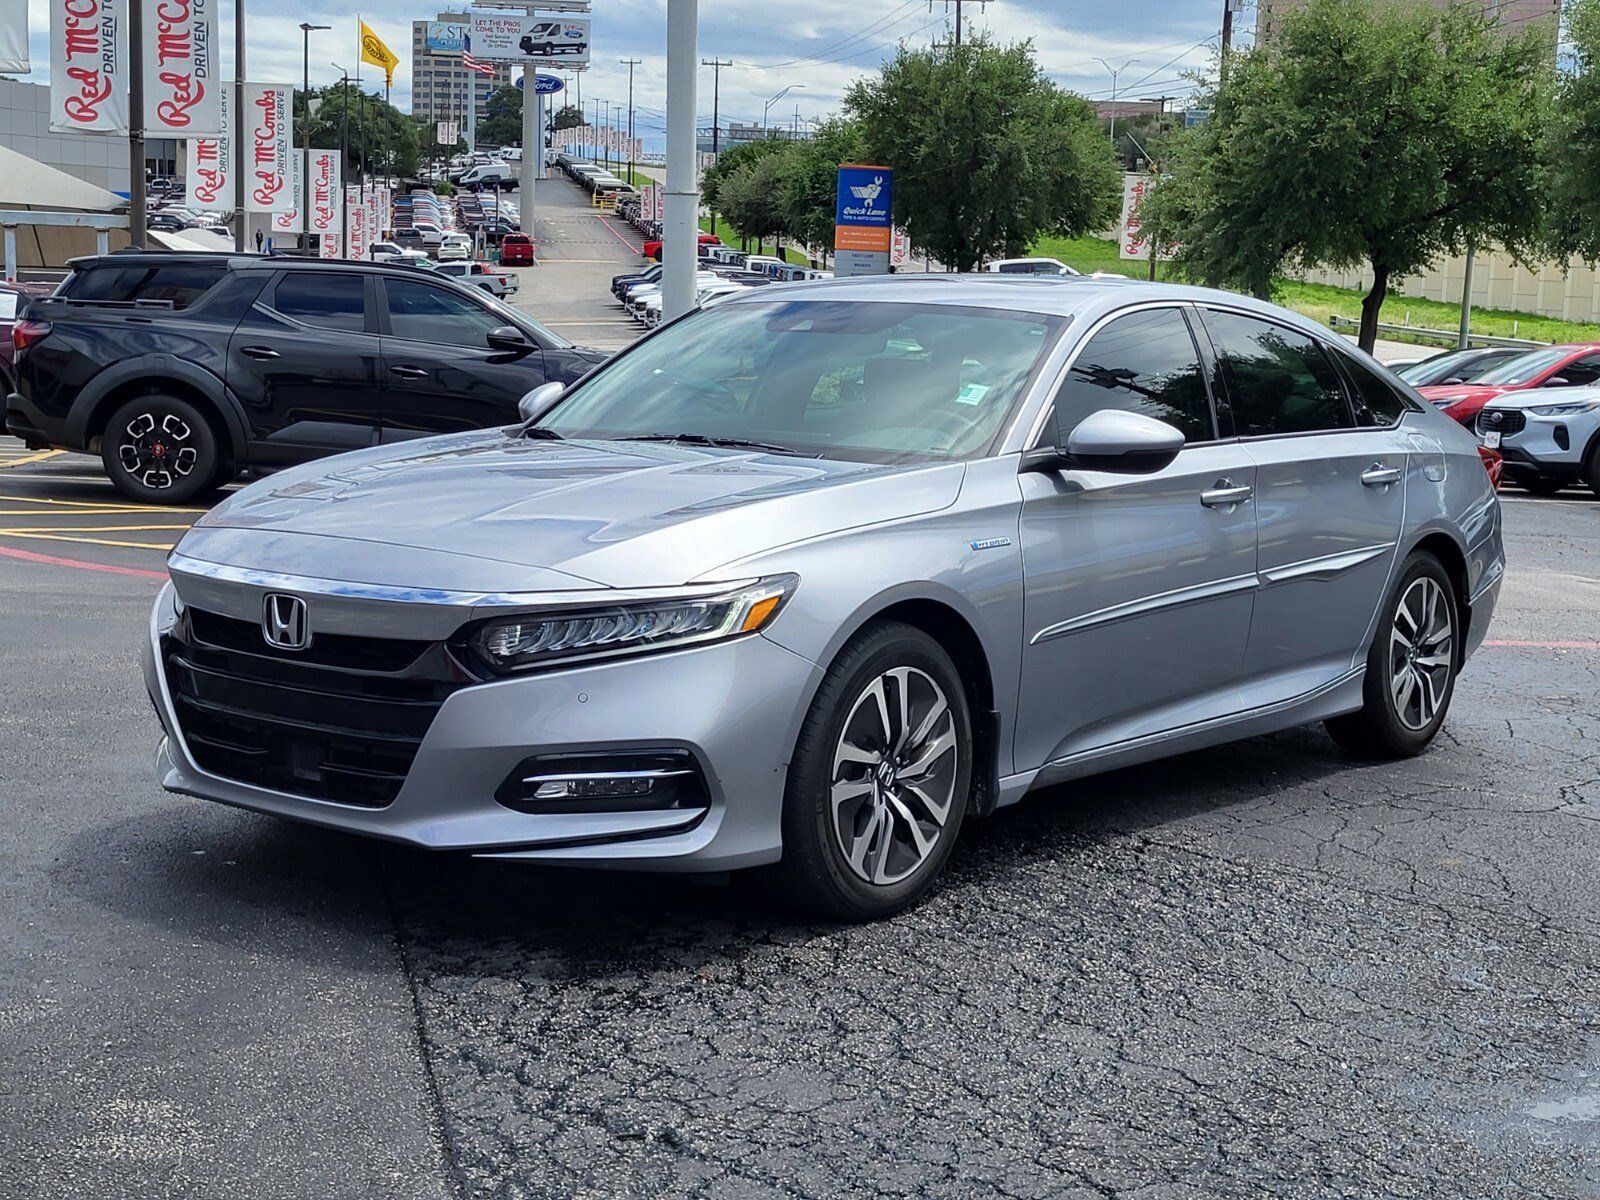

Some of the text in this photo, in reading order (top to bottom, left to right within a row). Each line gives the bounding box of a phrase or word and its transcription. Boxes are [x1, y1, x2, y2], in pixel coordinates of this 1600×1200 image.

[475, 18, 521, 28] LET THE PROS
[102, 16, 114, 74] DRIVEN
[193, 21, 206, 78] DRIVEN
[65, 67, 111, 122] Red
[157, 72, 204, 127] Red
[535, 77, 555, 90] ord
[253, 90, 283, 205] Red McCombs
[276, 90, 285, 175] DRIVEN TO SERVE
[219, 139, 228, 173] DRIVEN
[195, 168, 225, 203] Red
[293, 174, 299, 186] TO
[314, 155, 333, 229] Red McCombs
[329, 174, 335, 186] TO
[843, 206, 886, 216] Quick Lane
[978, 538, 1009, 548] HYBRID
